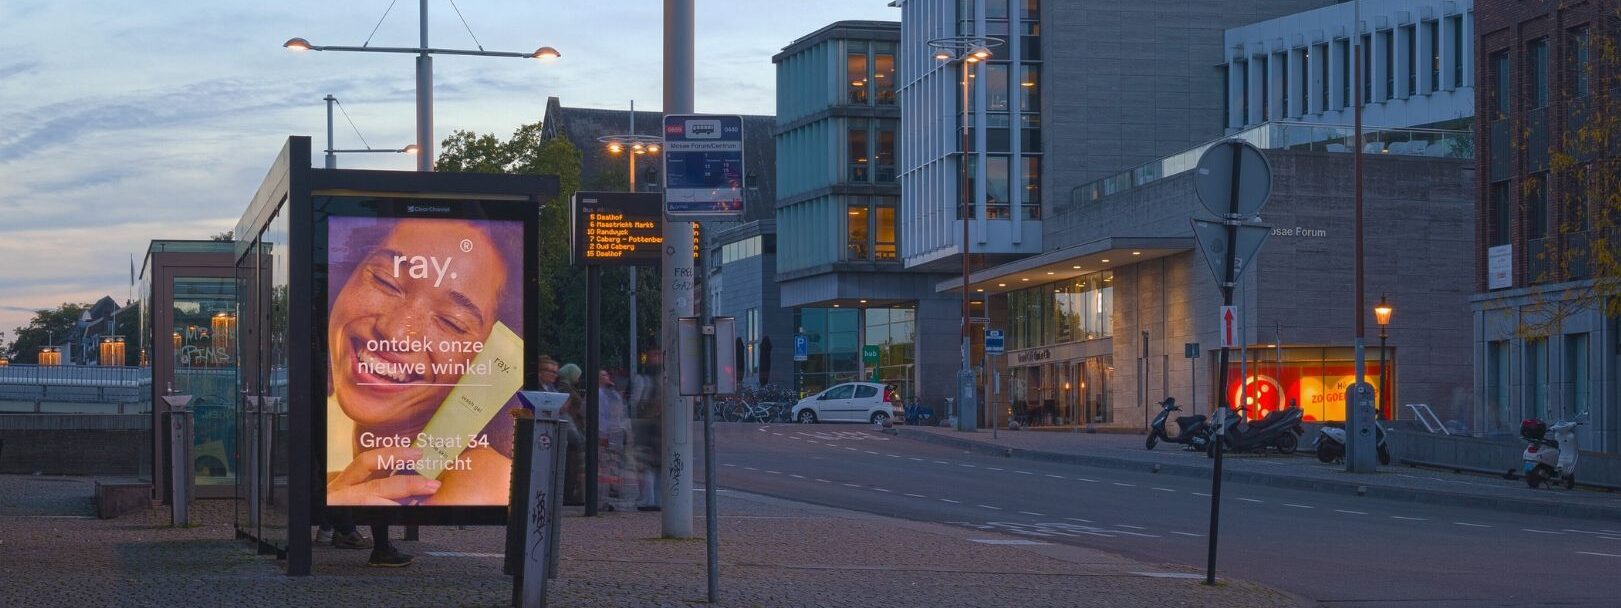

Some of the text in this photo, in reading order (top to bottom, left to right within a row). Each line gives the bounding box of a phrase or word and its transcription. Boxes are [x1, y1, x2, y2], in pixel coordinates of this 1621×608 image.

[1296, 227, 1326, 237] Forum
[392, 254, 457, 288] ray.
[366, 336, 484, 353] ontdek onze
[797, 338, 803, 347] P
[357, 359, 492, 375] nieuwe winkel
[494, 356, 510, 374] ray.
[1326, 393, 1347, 403] GOE
[360, 432, 411, 448] Grote
[417, 432, 461, 448] Staat
[468, 433, 489, 449] 34
[377, 455, 472, 471] Maastricht
